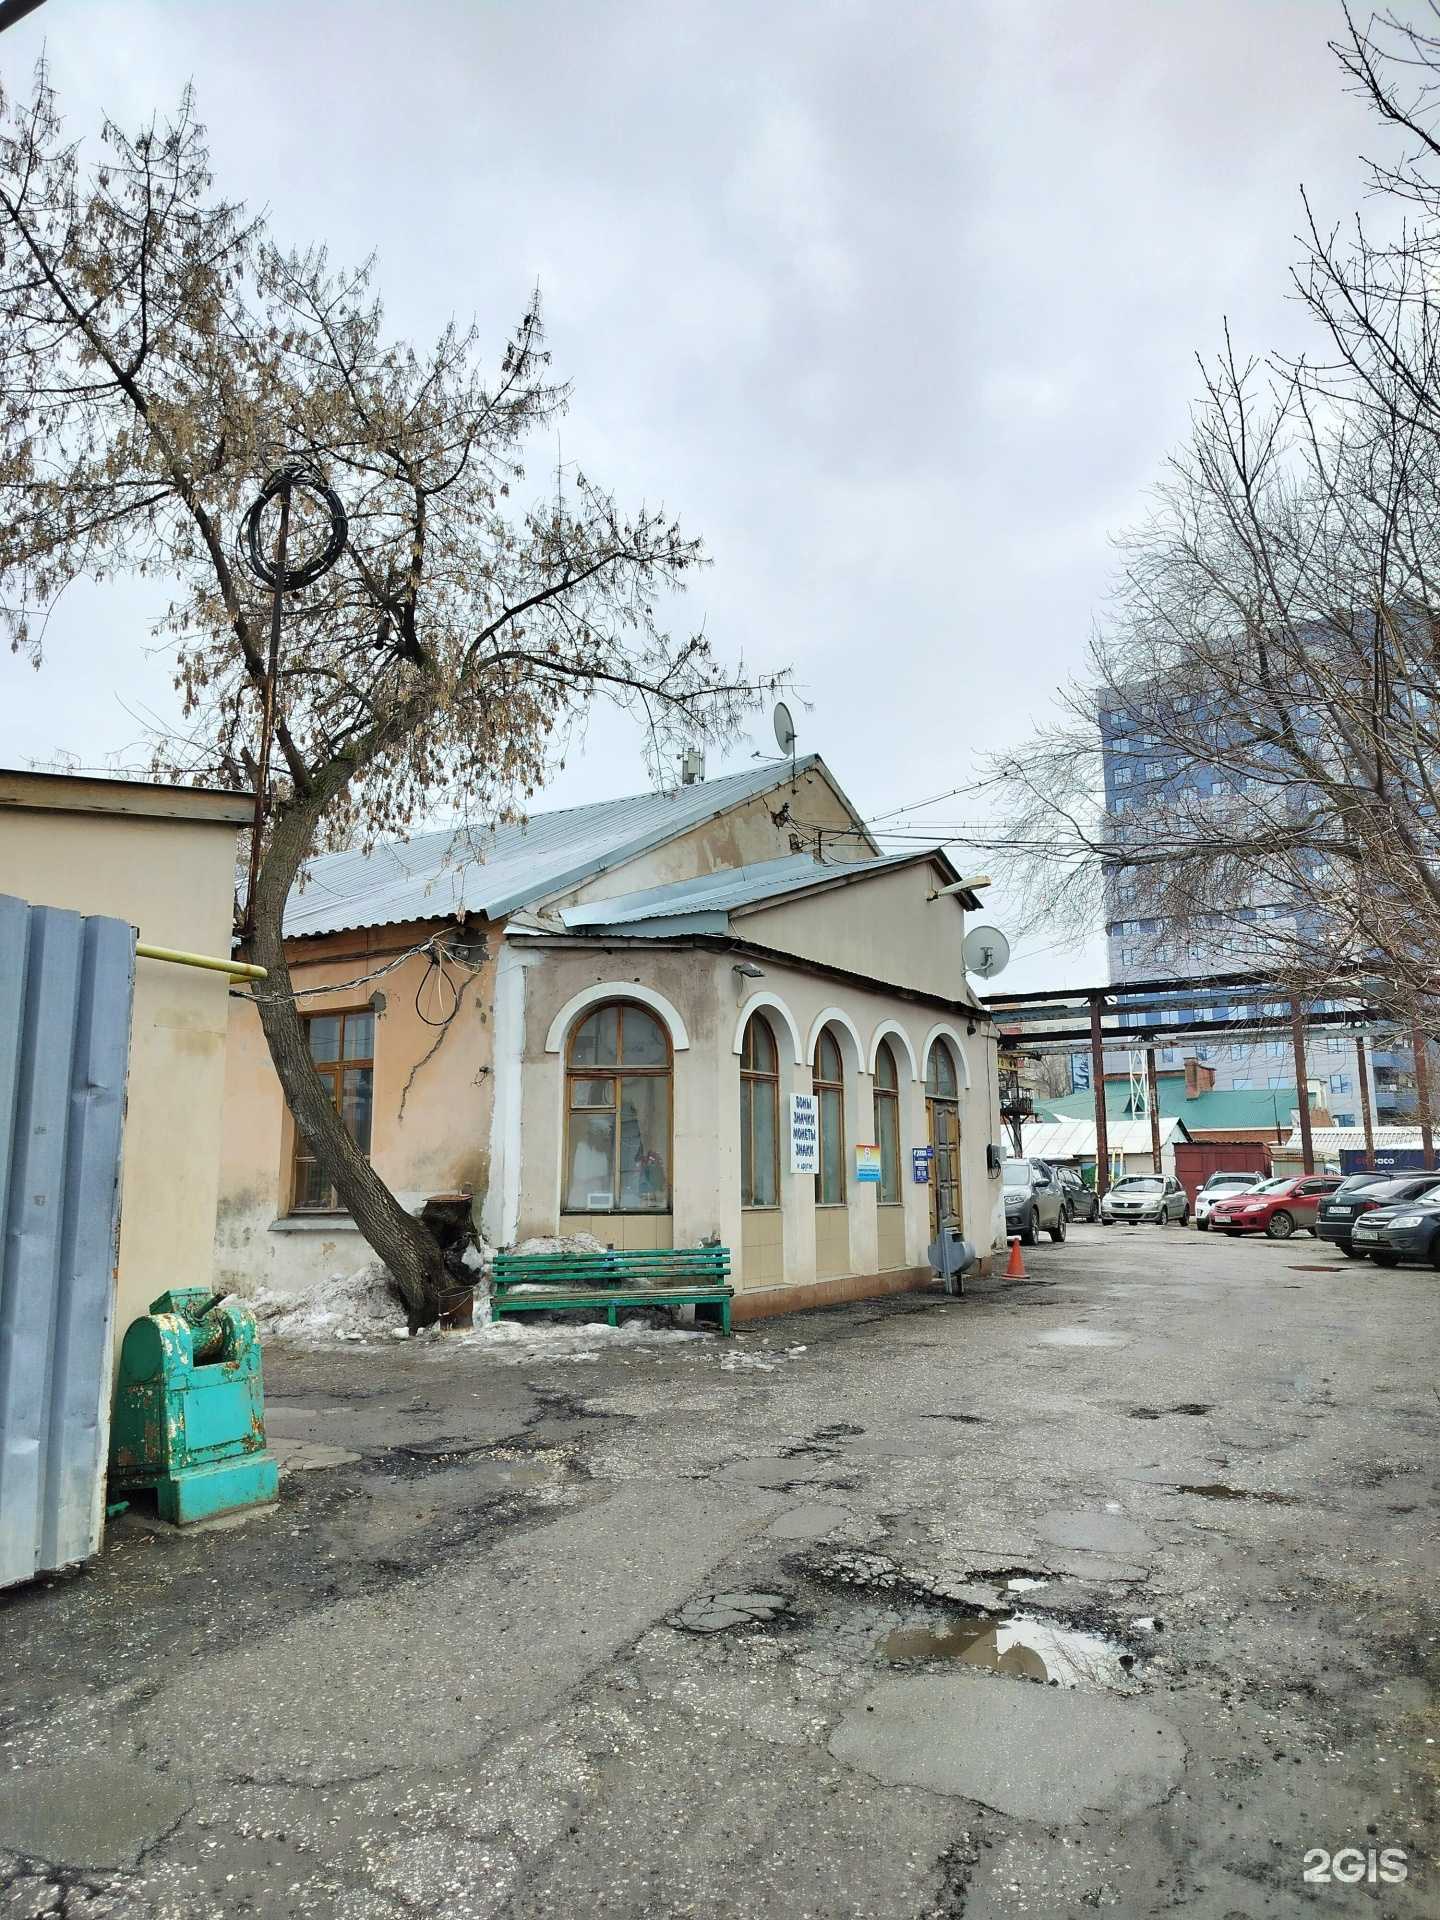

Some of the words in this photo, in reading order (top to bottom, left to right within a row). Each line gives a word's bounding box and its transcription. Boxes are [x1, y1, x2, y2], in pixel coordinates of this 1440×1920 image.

[793, 1112, 815, 1126] ЗНАЧКИ
[793, 1127, 816, 1141] МОНЕТЫ
[795, 1143, 814, 1157] ЗНАКИ
